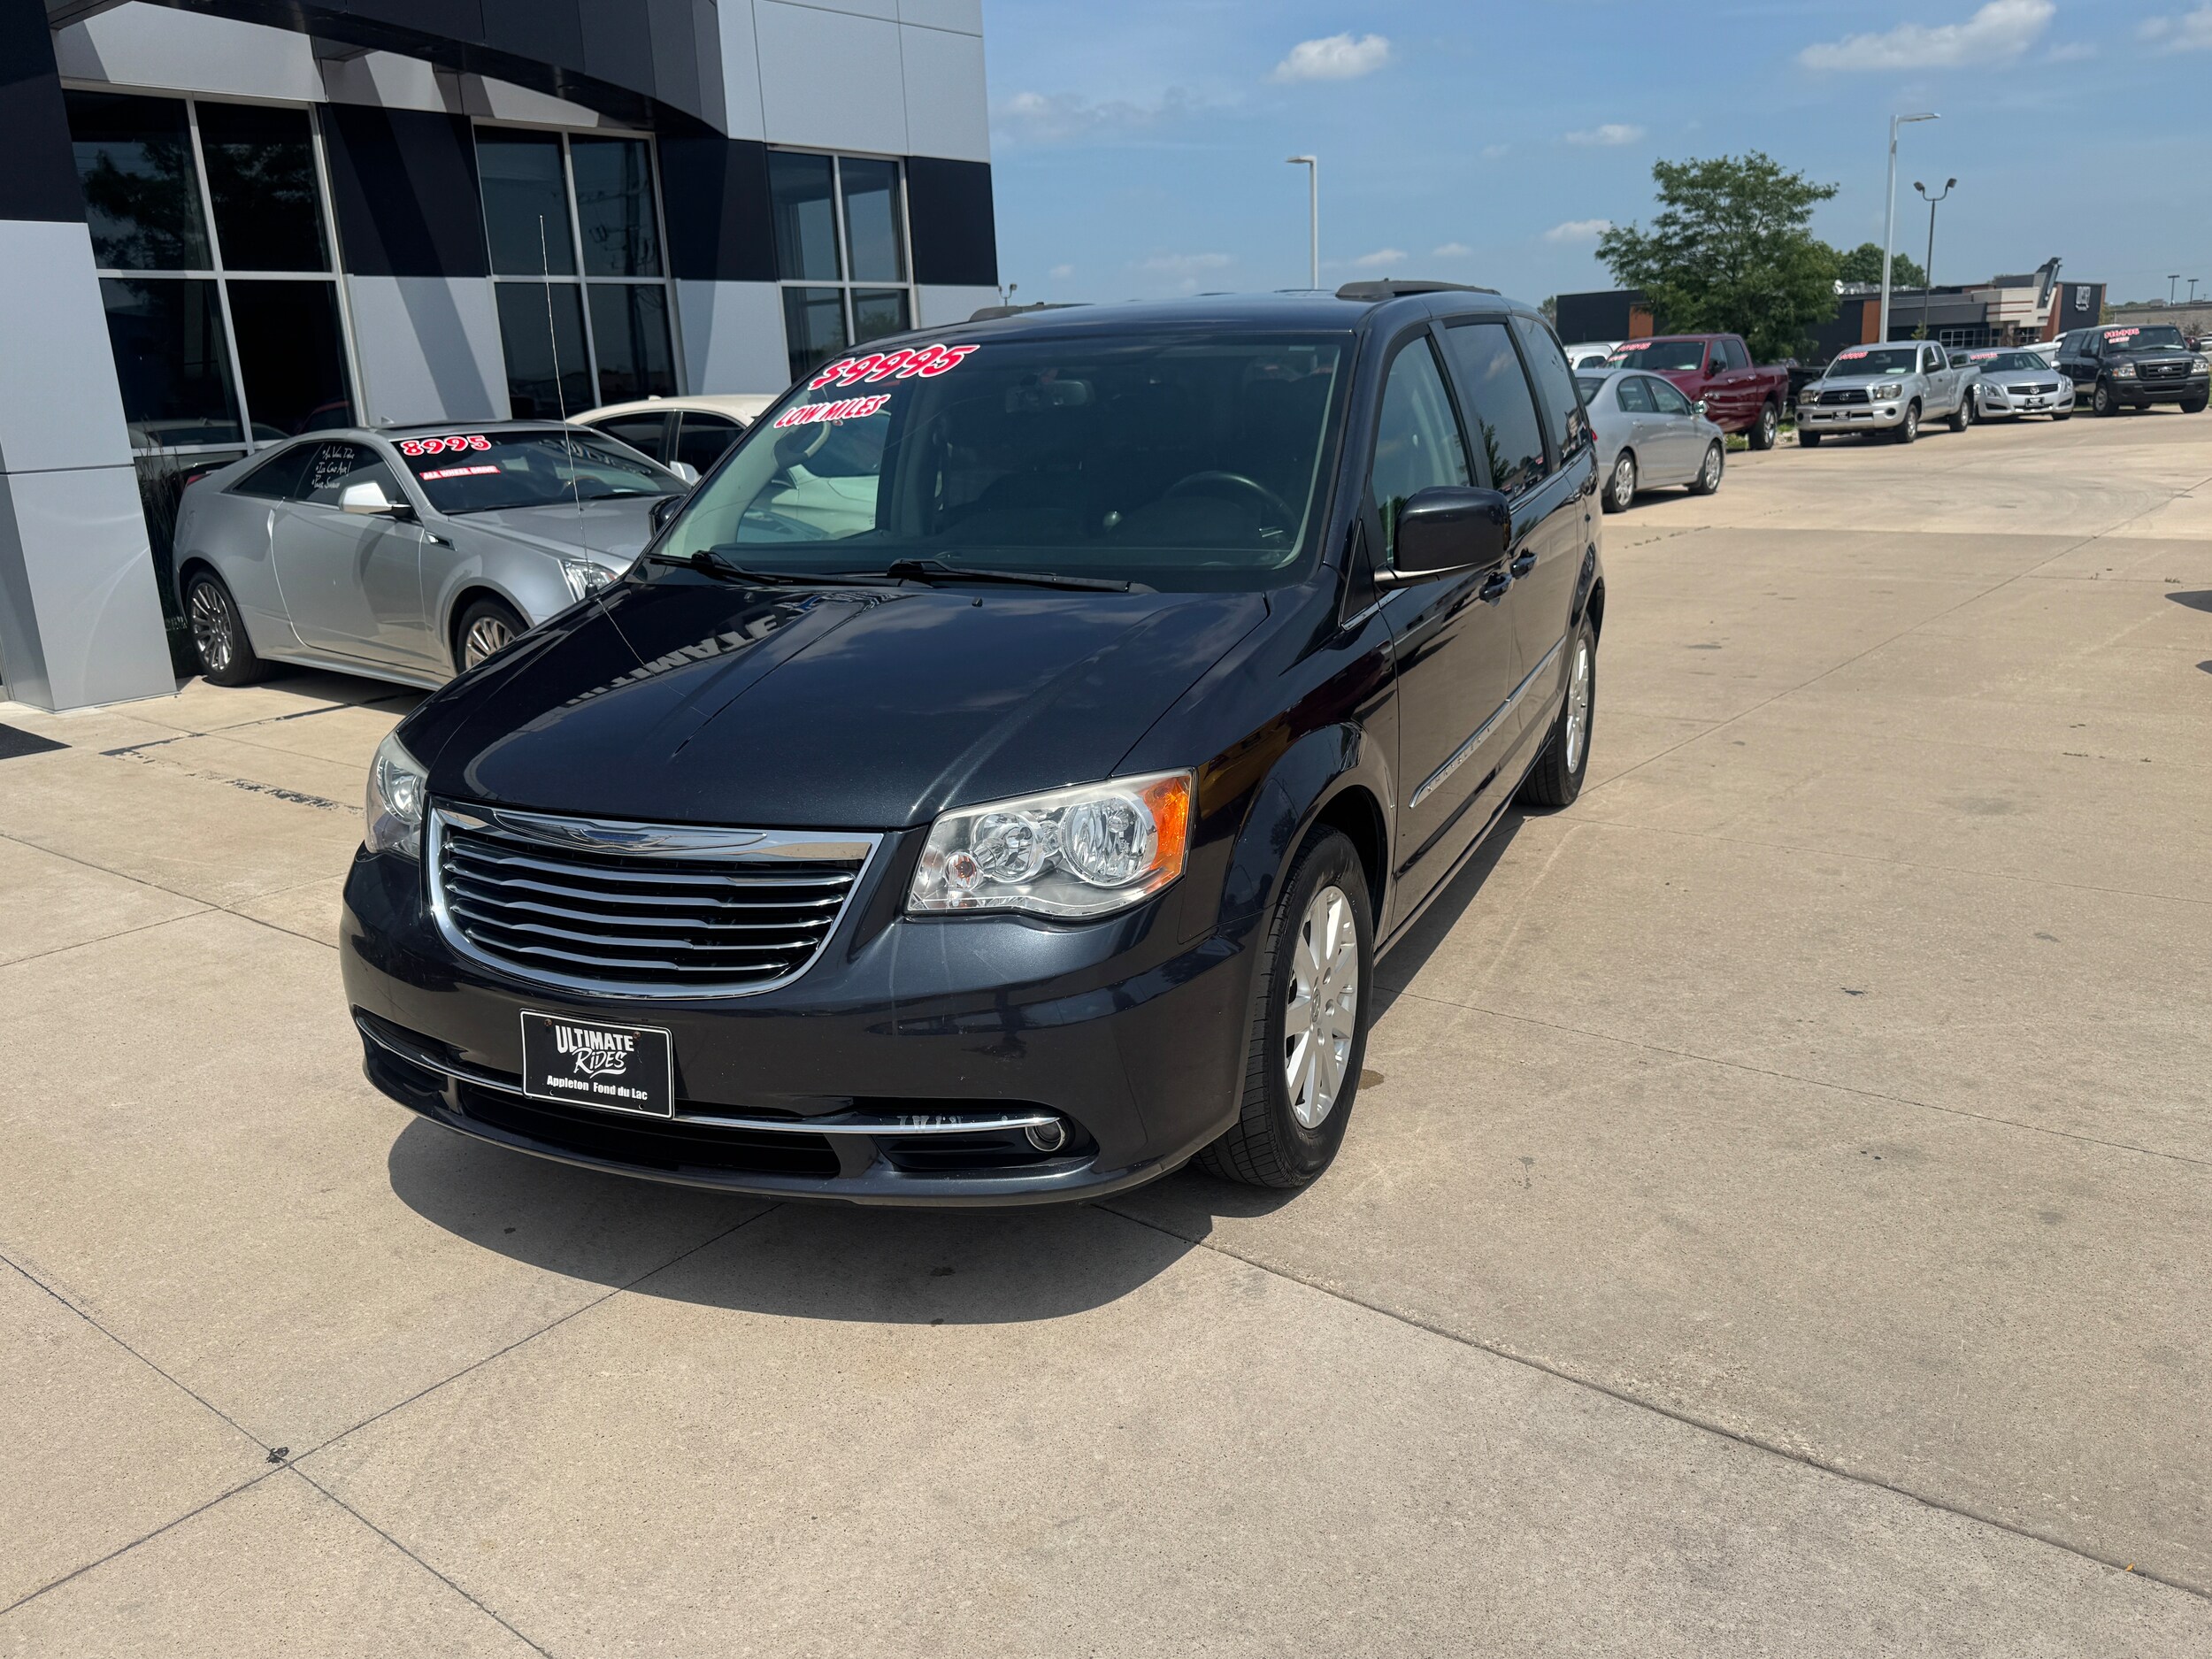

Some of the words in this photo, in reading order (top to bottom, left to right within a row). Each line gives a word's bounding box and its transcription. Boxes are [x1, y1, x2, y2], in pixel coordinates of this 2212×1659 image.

[807, 343, 980, 391] $9995
[773, 401, 826, 428] LOW
[819, 394, 891, 422] MILES
[400, 434, 492, 456] 8995
[555, 1025, 634, 1054] ULTIMATE
[546, 1074, 589, 1092] Appleton
[593, 1081, 616, 1095] Fond
[617, 1086, 631, 1098] du
[632, 1087, 649, 1101] Lac
